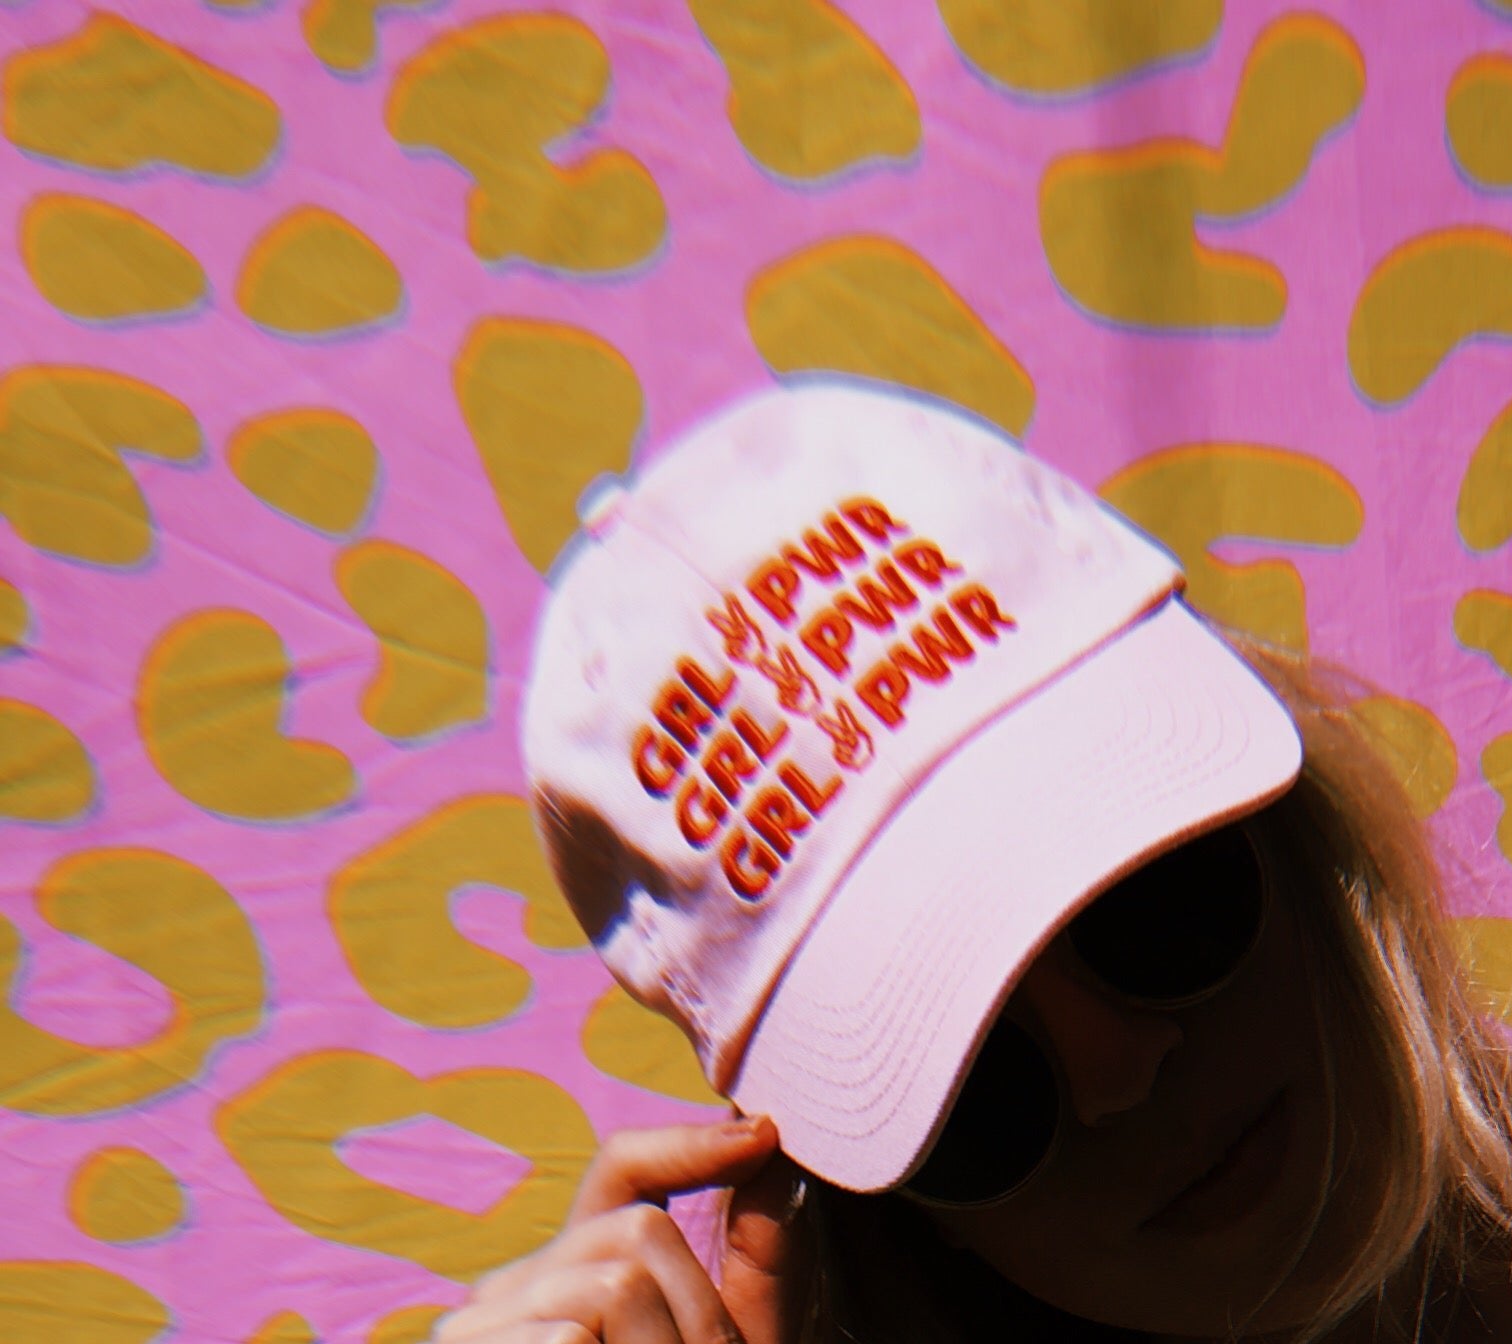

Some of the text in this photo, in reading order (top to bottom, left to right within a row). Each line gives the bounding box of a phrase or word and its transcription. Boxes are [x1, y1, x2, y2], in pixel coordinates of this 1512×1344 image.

[631, 496, 911, 800] GRL PWR
[674, 539, 965, 850] GRL PWR
[719, 583, 1018, 902] GRL PWR
